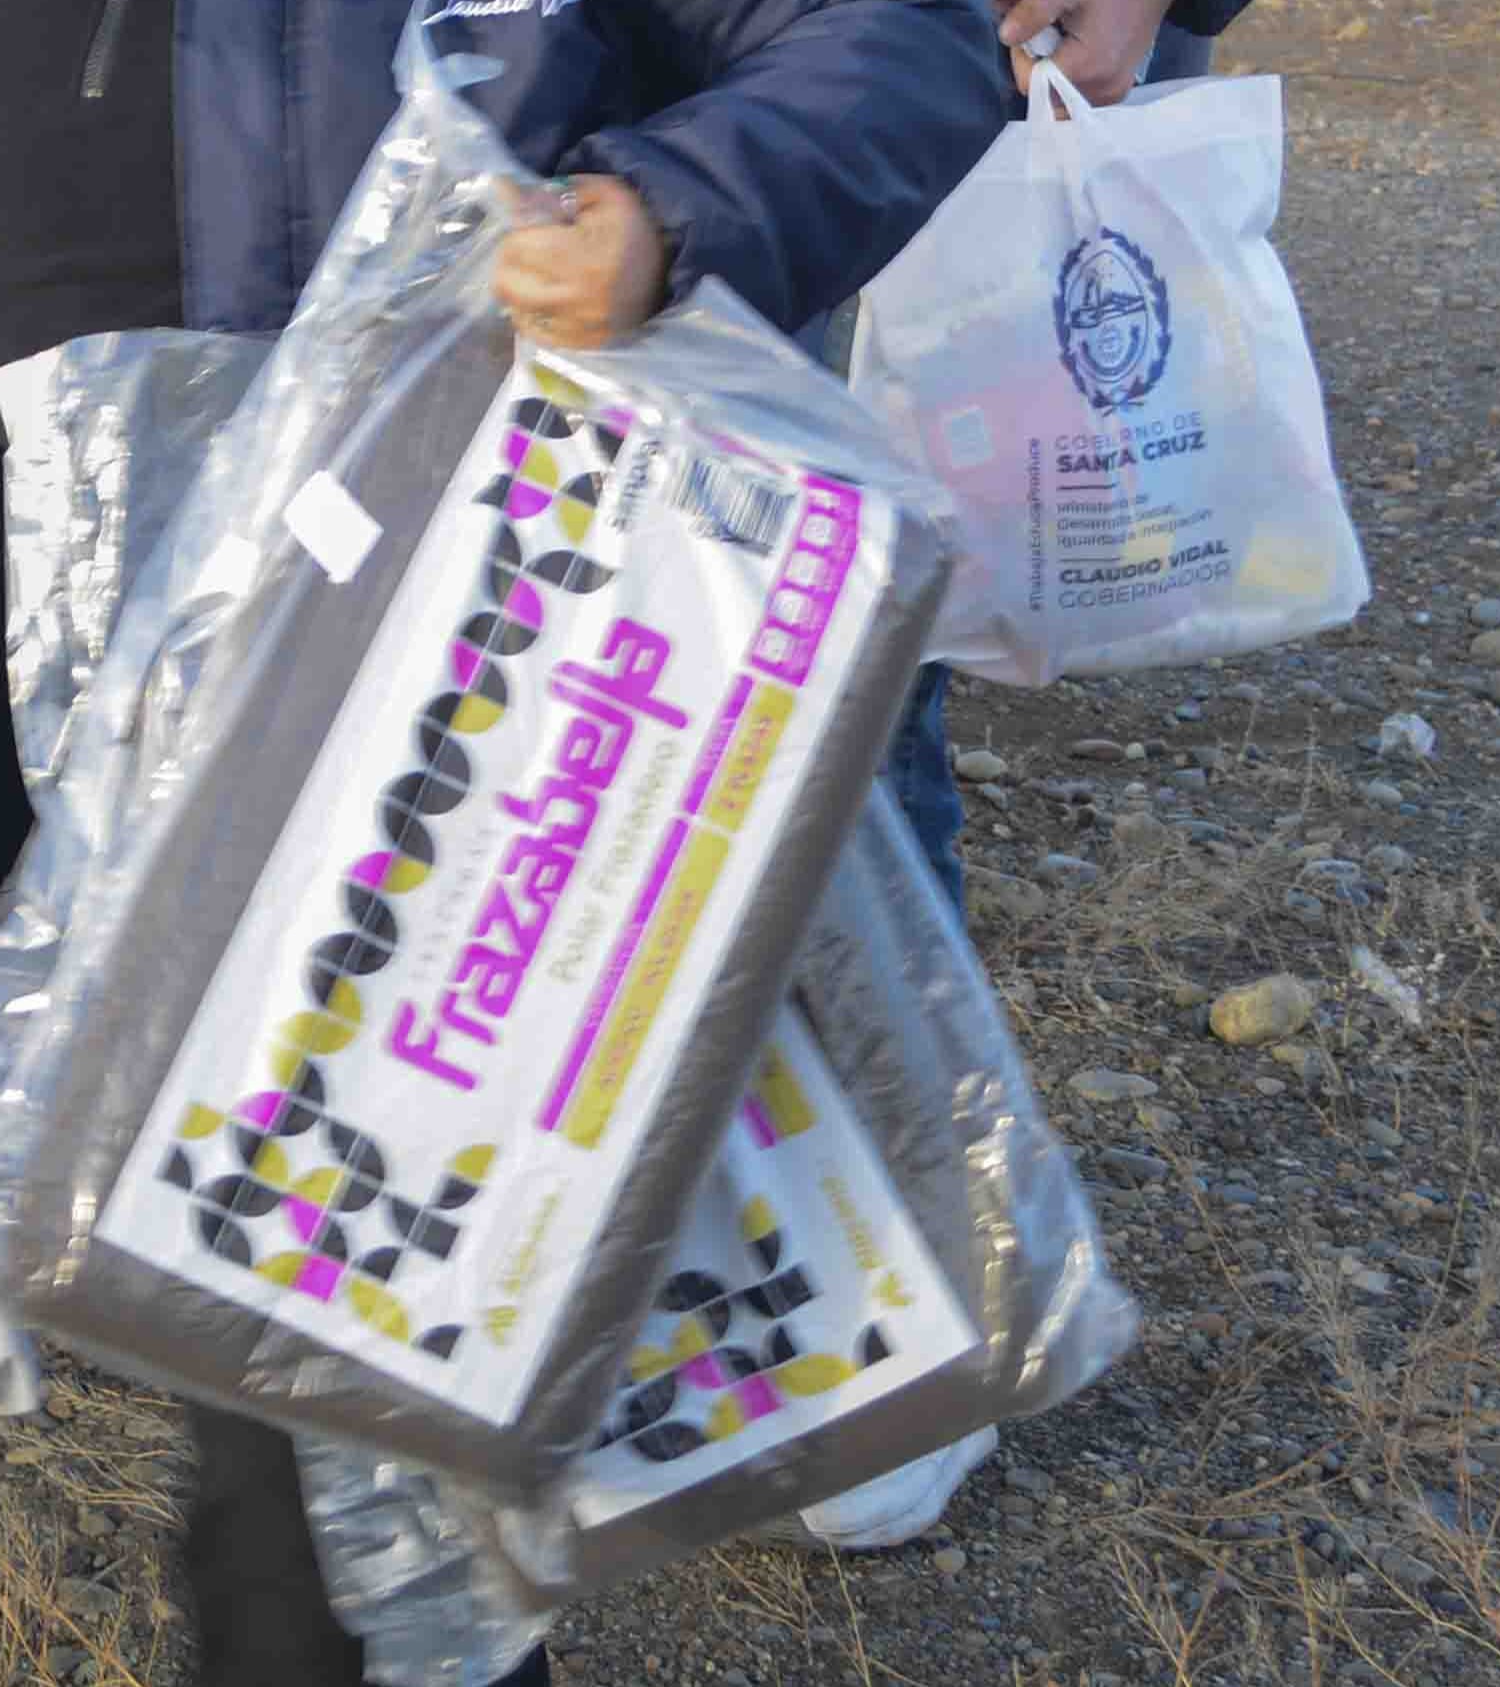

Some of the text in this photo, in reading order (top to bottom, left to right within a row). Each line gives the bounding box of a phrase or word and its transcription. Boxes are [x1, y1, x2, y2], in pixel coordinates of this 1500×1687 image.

[1056, 430, 1207, 474] SANTA CRUZ
[1058, 560, 1231, 610] GOBERNADOR
[1059, 539, 1230, 585] CLAUDIO VIDAL
[383, 616, 690, 1091] Frazabella
